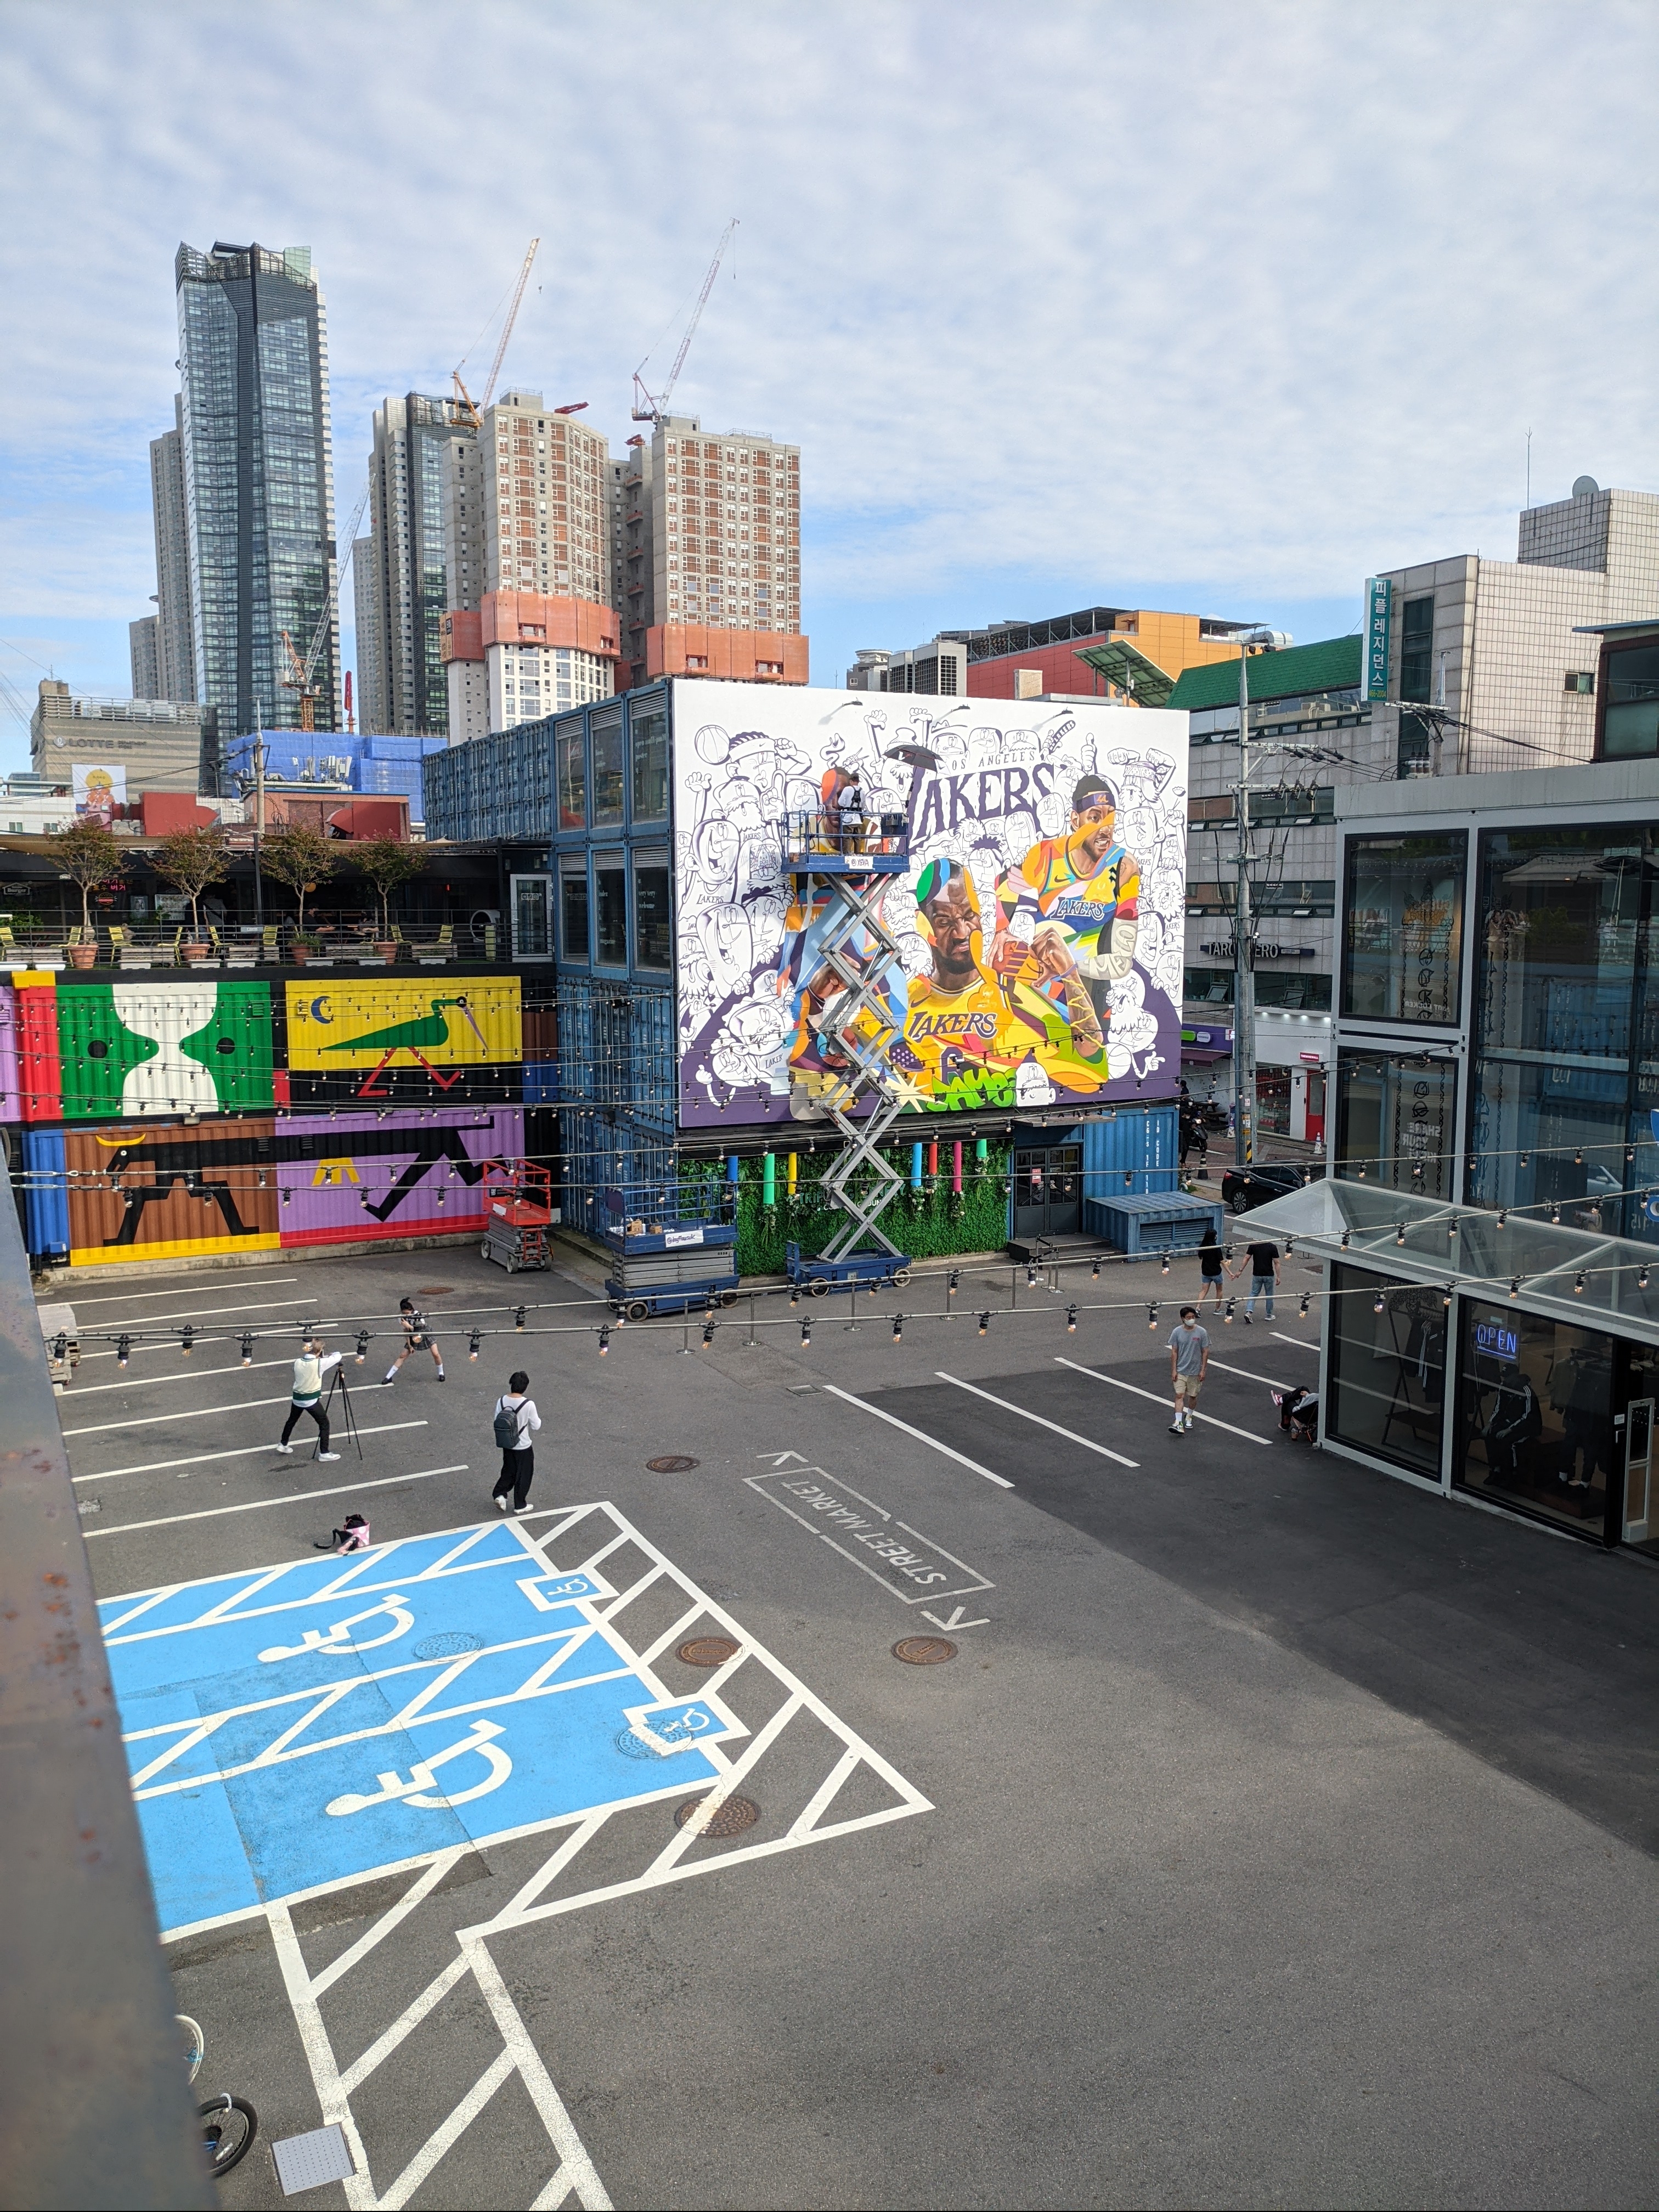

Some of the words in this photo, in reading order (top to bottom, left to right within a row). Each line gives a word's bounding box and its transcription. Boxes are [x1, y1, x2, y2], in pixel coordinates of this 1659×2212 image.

[1372, 581, 1387, 686] 피플레지던스
[69, 738, 114, 749] LOTTE
[978, 751, 1035, 768] ANGELES
[743, 830, 761, 842] LAKERS
[696, 894, 724, 905] LAKERS
[1050, 896, 1105, 921] LAKERS
[907, 1011, 998, 1043] LAKERS
[765, 1054, 783, 1069] LAKER
[1156, 1120, 1160, 1133] ID
[1477, 1324, 1516, 1354] OPEN
[781, 1481, 873, 1530] MARKET
[853, 1532, 947, 1584] STREET
